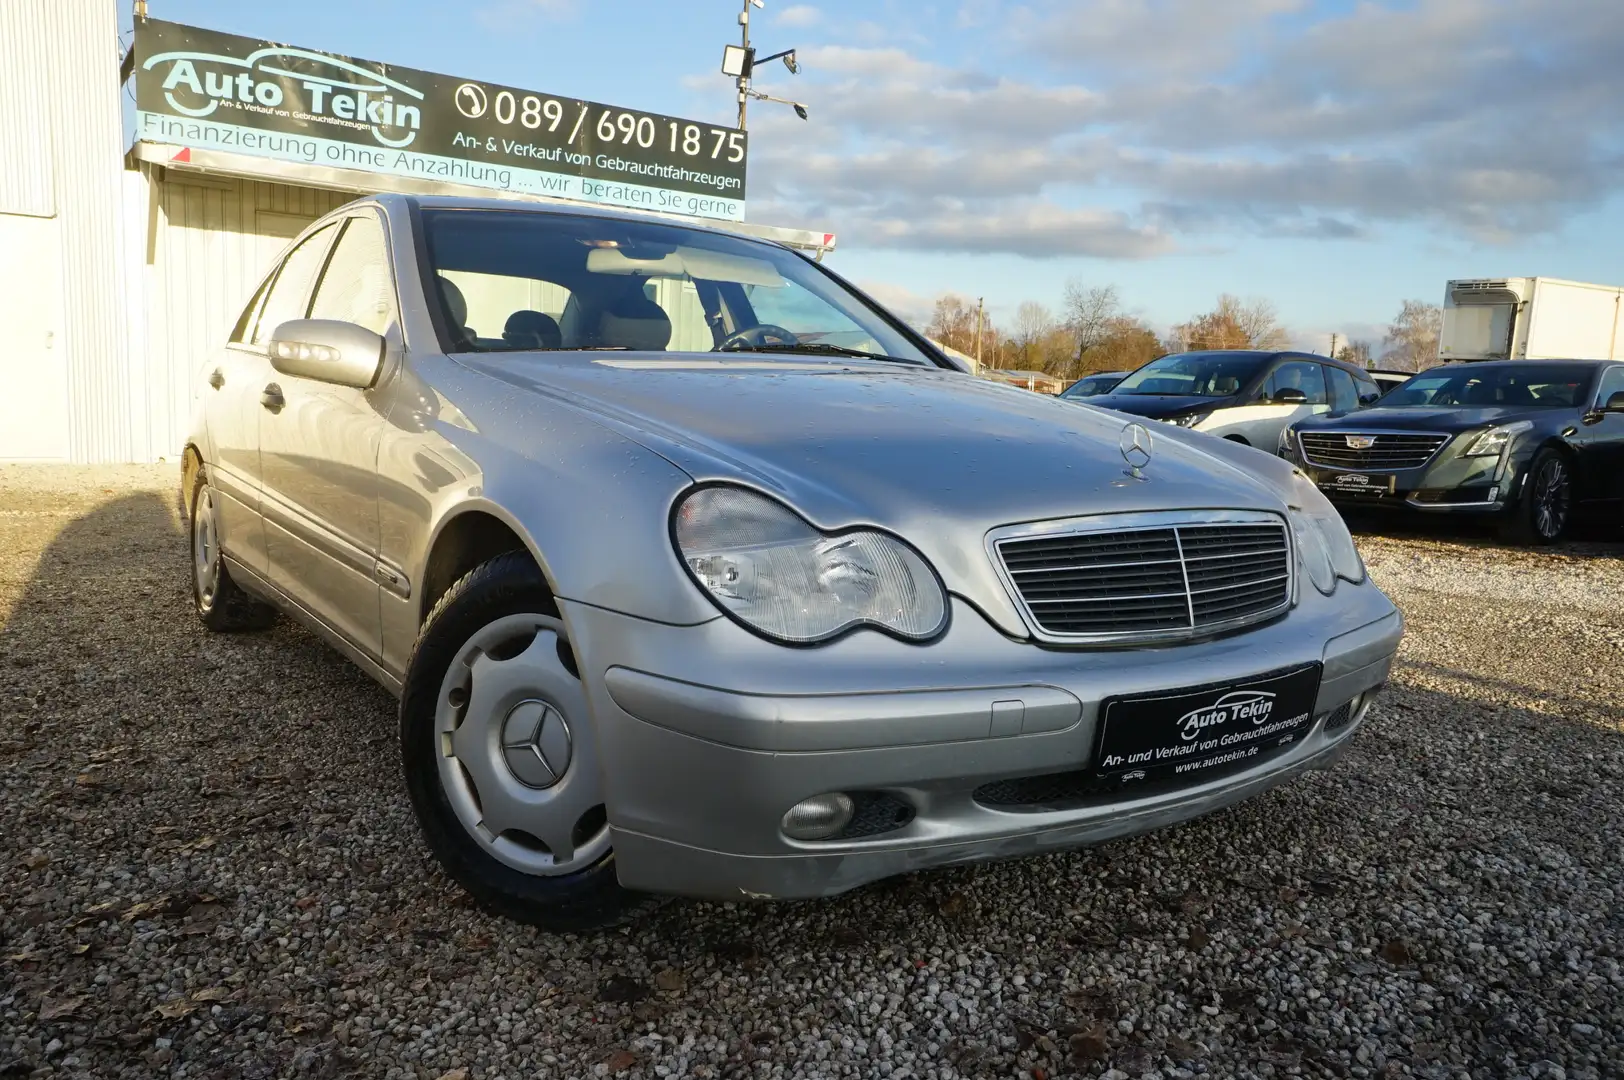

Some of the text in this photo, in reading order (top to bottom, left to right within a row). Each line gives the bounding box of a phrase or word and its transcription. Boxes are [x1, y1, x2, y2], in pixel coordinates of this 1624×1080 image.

[161, 59, 421, 129] Auto Tekin
[244, 103, 274, 116] Verkauf
[275, 109, 290, 117] von
[292, 110, 371, 131] Gebrauchtfahrzeugen
[494, 91, 745, 163] 089 / 690 18 75
[143, 113, 317, 162] Finanzierung
[326, 144, 385, 167] ohne
[393, 151, 511, 189] Anzahlung
[540, 174, 570, 192] wir
[581, 178, 652, 204] beraten
[658, 189, 682, 208] Sie
[687, 196, 737, 216] gerne
[452, 131, 741, 189] An- & Verkauf von Gebrauchtfahrzeugen
[1103, 754, 1125, 767] An-
[1127, 749, 1153, 764] und
[1155, 741, 1199, 760] Verkauf
[1199, 738, 1217, 751] von
[1220, 712, 1309, 746] Gebrauchtfahrzeugen
[1184, 699, 1273, 731] Auto Tekin
[1175, 746, 1259, 774] www.autotekin.de
